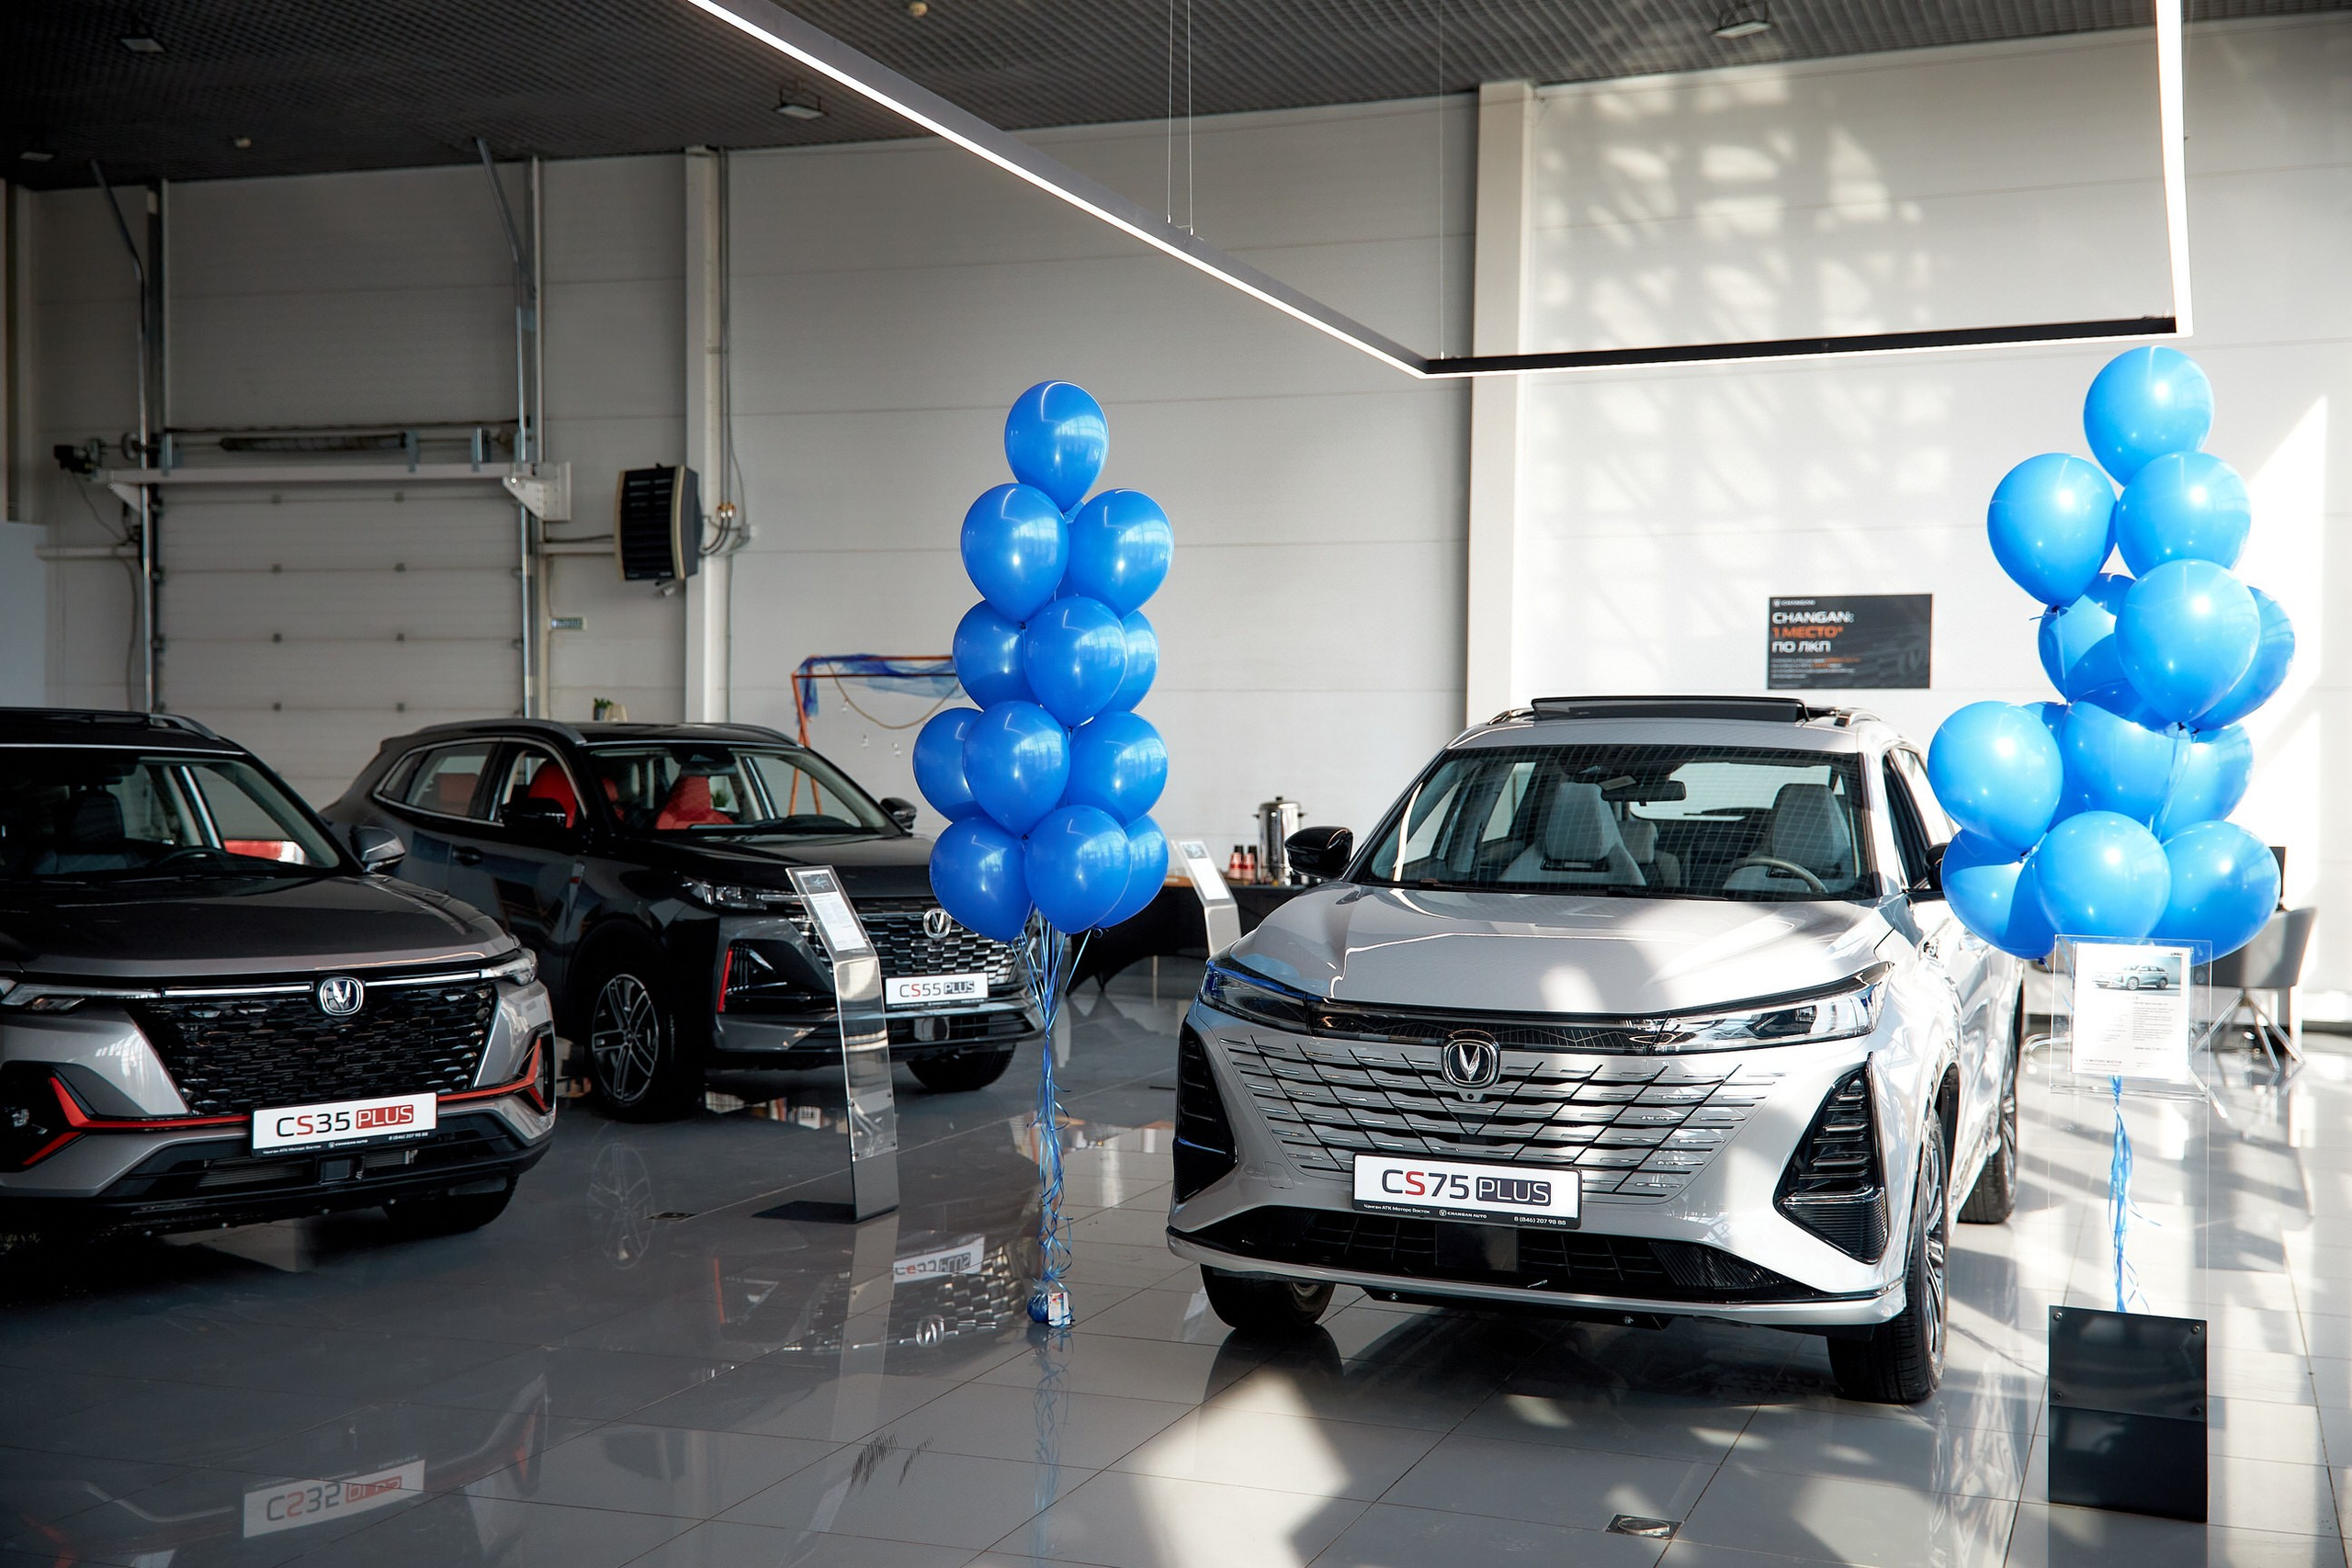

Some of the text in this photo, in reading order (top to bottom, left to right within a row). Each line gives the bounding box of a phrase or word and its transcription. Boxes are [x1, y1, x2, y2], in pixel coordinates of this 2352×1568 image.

[1772, 611, 1854, 625] CHANGAN:
[1772, 626, 1781, 638] 1
[1771, 640, 1832, 653] ПО ЛКП
[899, 982, 975, 998] CS55 PLUS
[277, 1105, 413, 1137] CS35 PLUS
[1381, 1168, 1550, 1205] CS75 PLUS
